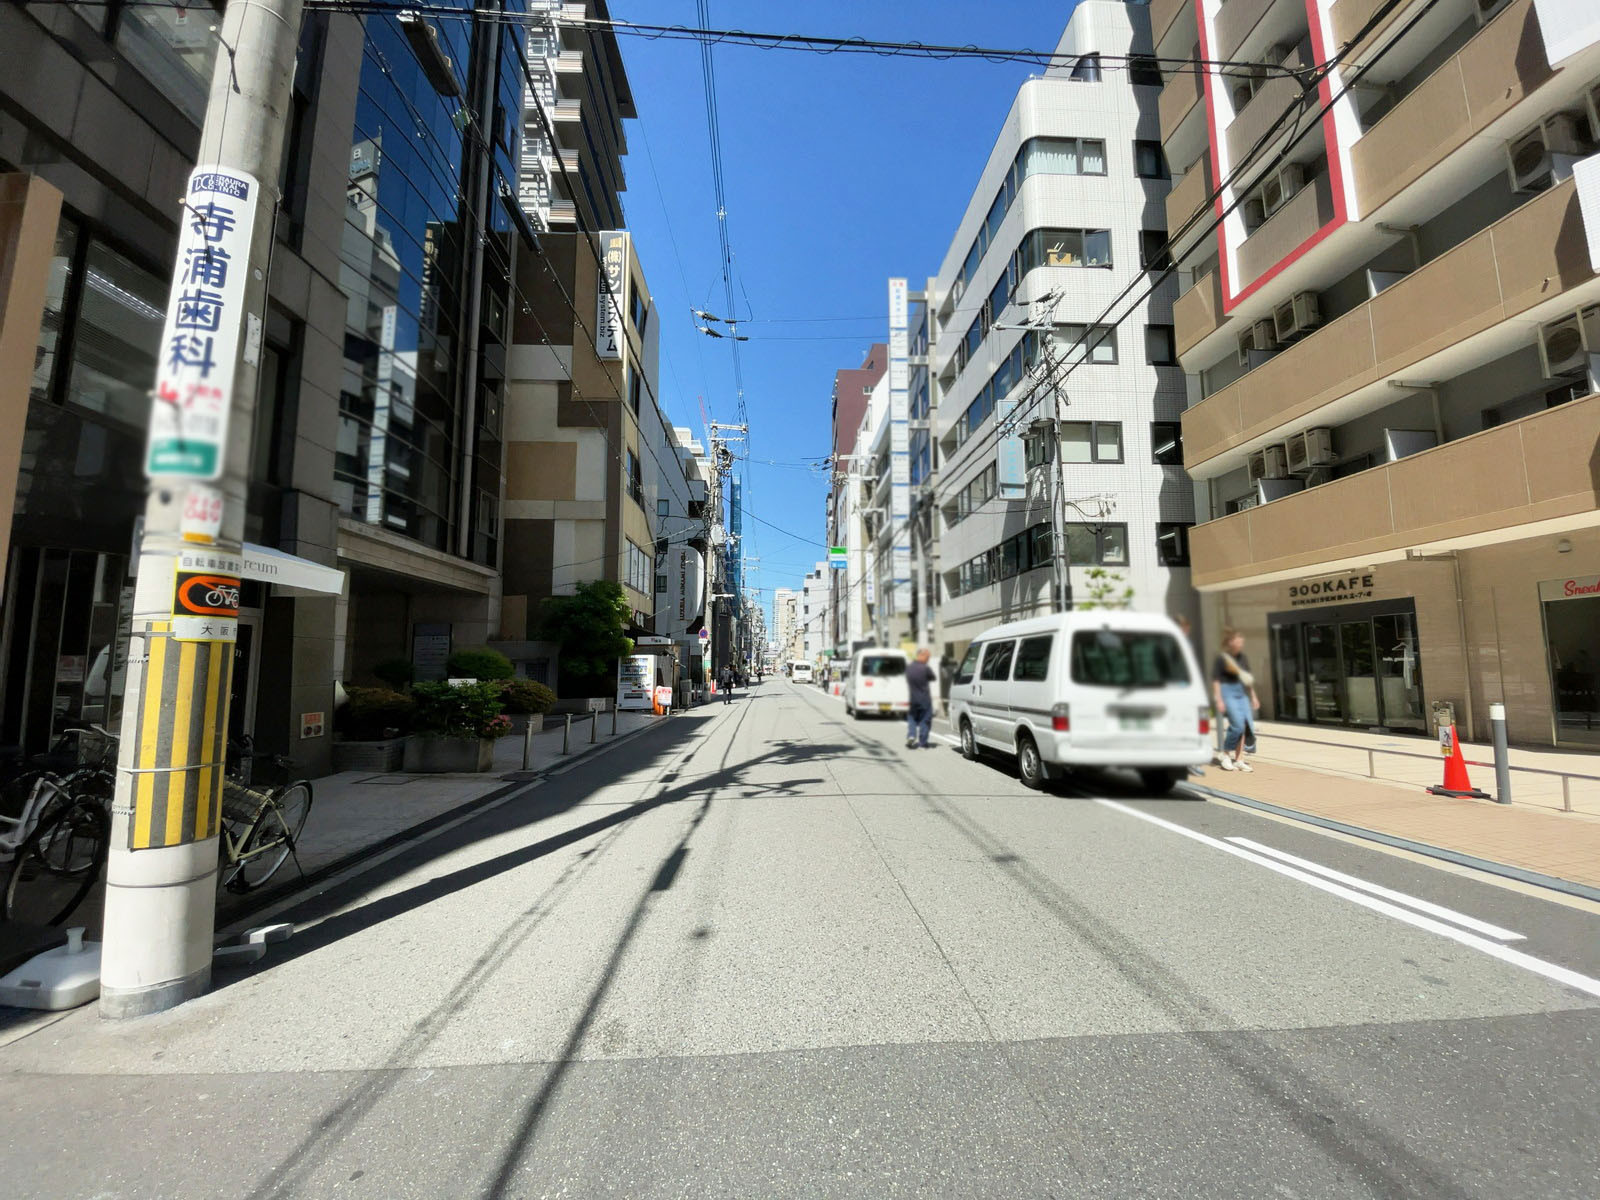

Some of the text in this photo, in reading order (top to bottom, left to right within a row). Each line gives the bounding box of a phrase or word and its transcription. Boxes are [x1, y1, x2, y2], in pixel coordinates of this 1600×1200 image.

[167, 201, 236, 379] 寺浦歯科
[1289, 575, 1374, 597] 300KAFE
[1564, 580, 1600, 597] Snea
